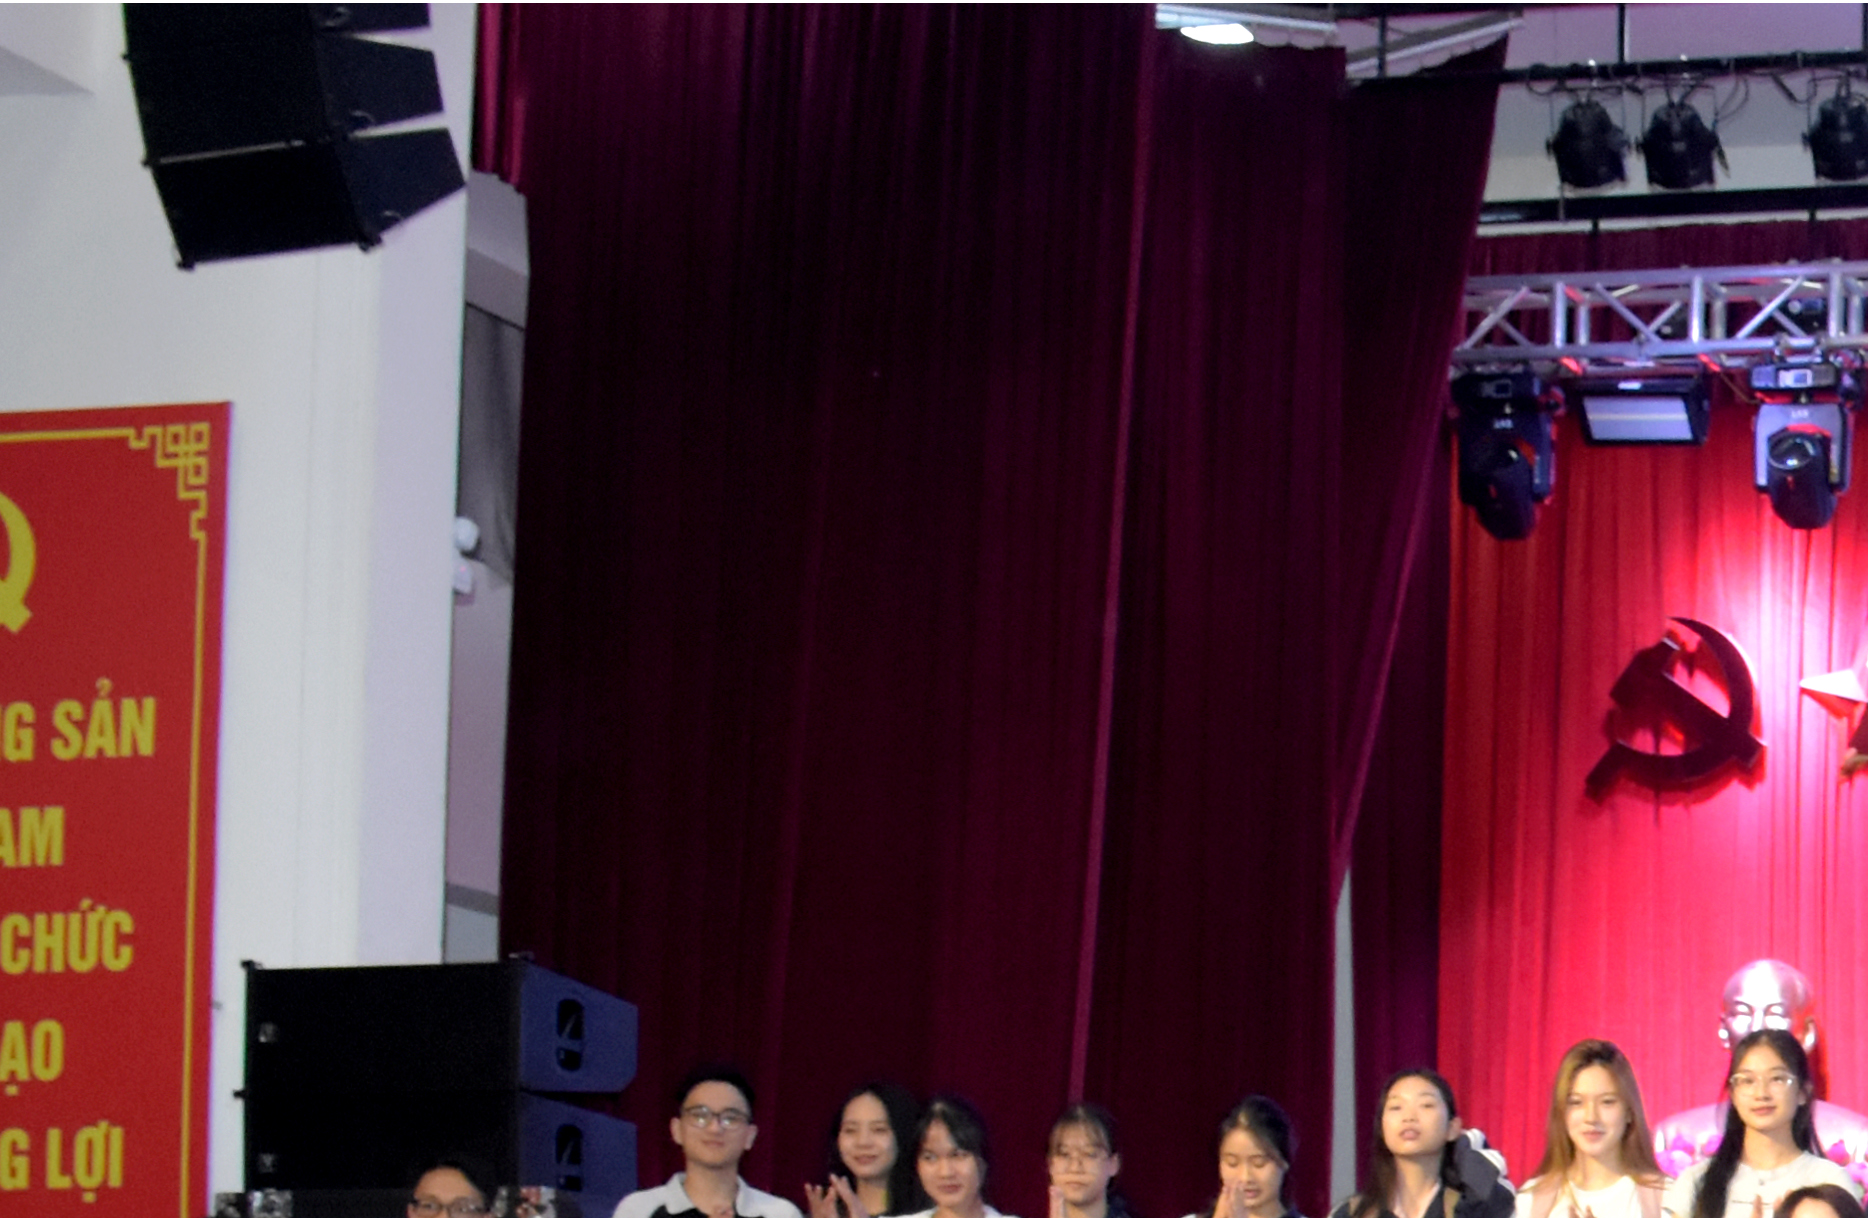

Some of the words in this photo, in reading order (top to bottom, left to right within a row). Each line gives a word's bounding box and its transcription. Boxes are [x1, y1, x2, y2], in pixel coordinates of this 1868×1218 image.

[51, 676, 156, 761] SẢN
[0, 898, 134, 974] CHỨC
[46, 1120, 123, 1203] LỢI
